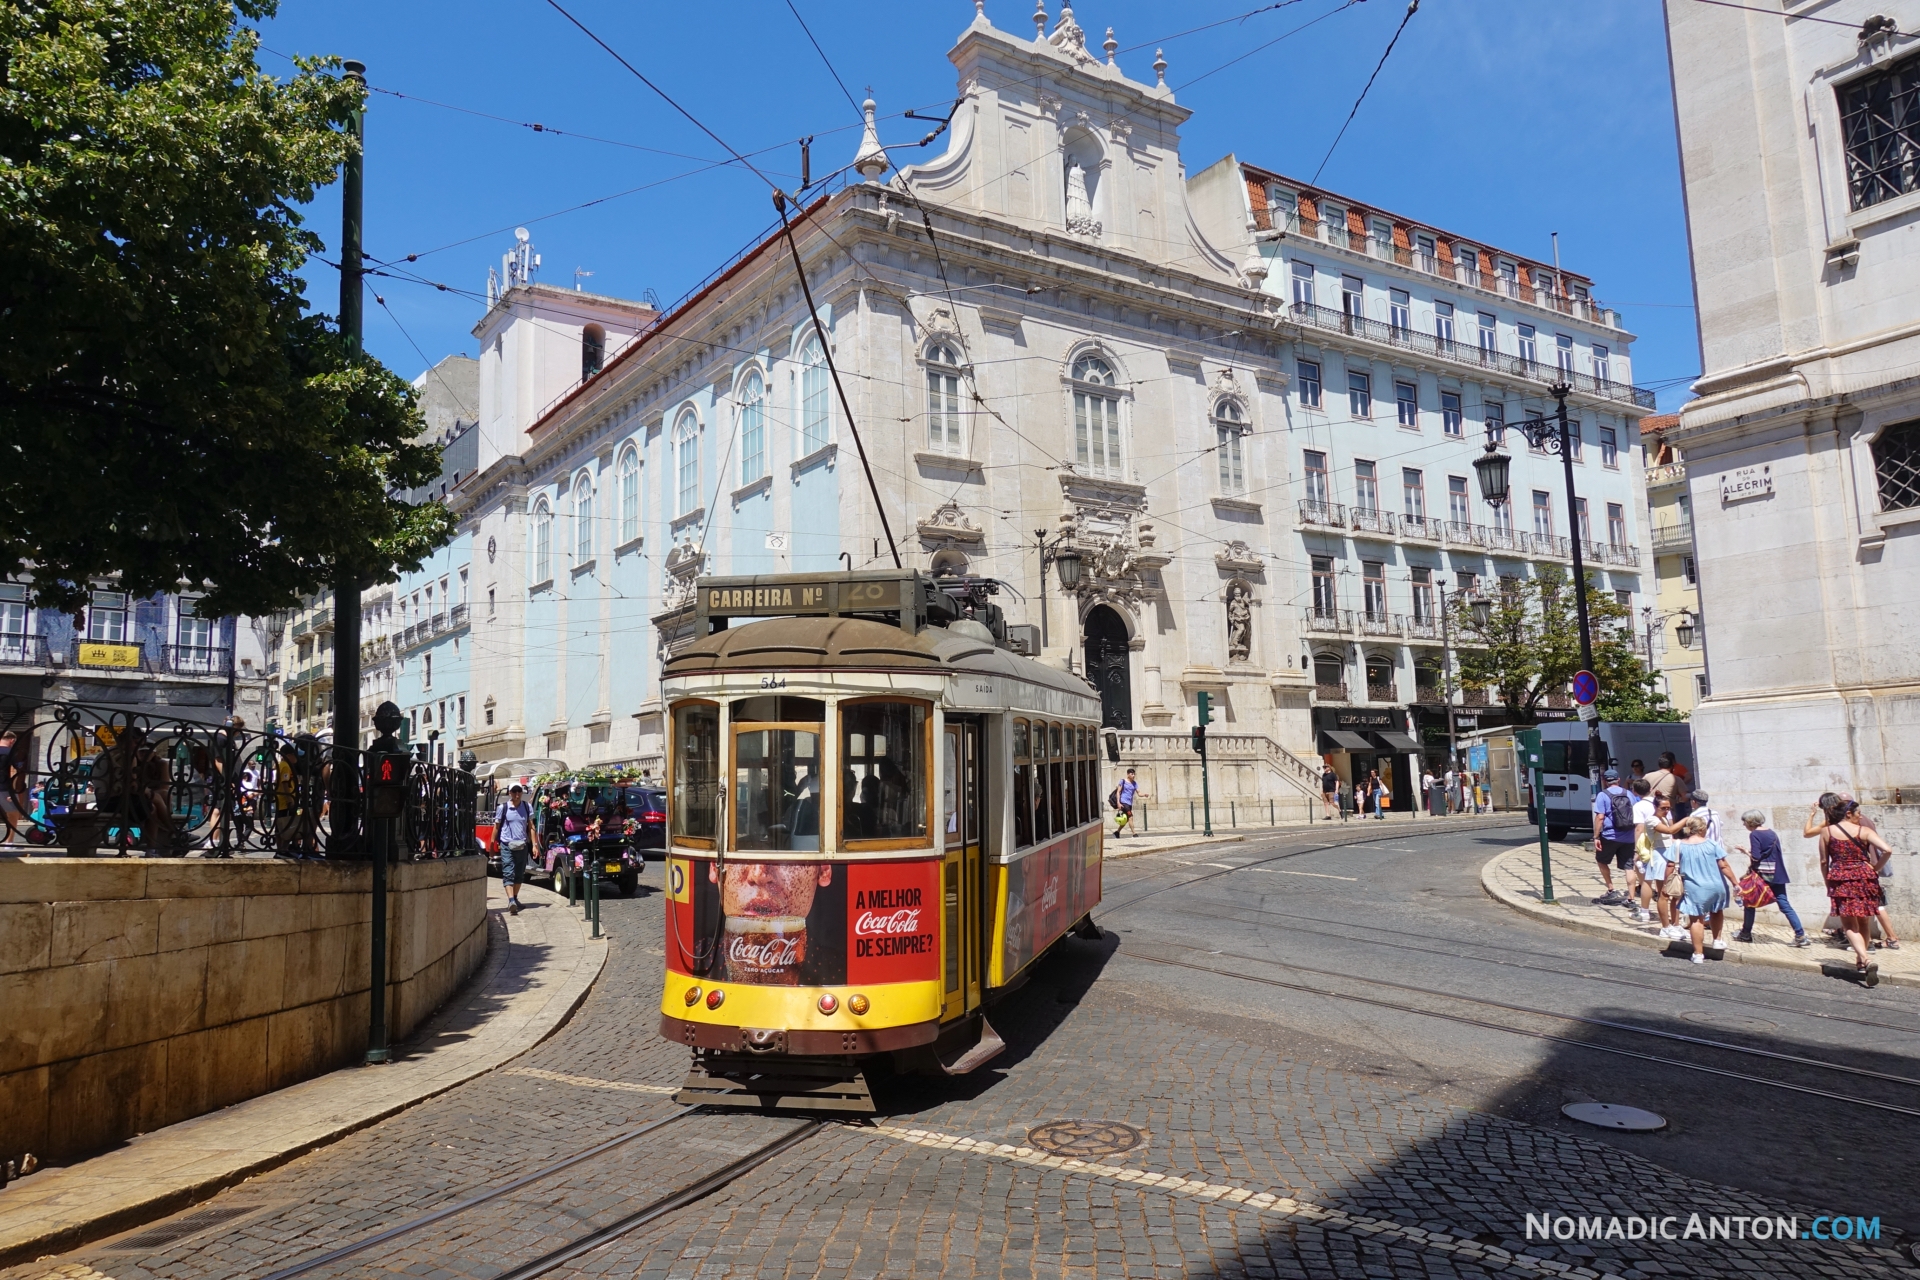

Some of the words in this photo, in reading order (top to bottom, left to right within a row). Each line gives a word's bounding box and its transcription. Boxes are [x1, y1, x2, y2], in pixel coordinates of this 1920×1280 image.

[1736, 468, 1756, 477] RUA
[1723, 477, 1773, 495] ALECRIM
[709, 588, 793, 608] CARREIRA
[850, 582, 885, 600] 28
[760, 677, 787, 689] 564
[975, 683, 993, 694] SAÍDA
[855, 890, 866, 910] A
[868, 887, 922, 909] MELHOR
[854, 908, 922, 935] Coca-Cola
[729, 936, 801, 966] Coca-Cola
[856, 938, 874, 958] DE
[875, 934, 934, 957] SEMPRE?
[760, 966, 785, 974] AÇÚCAR
